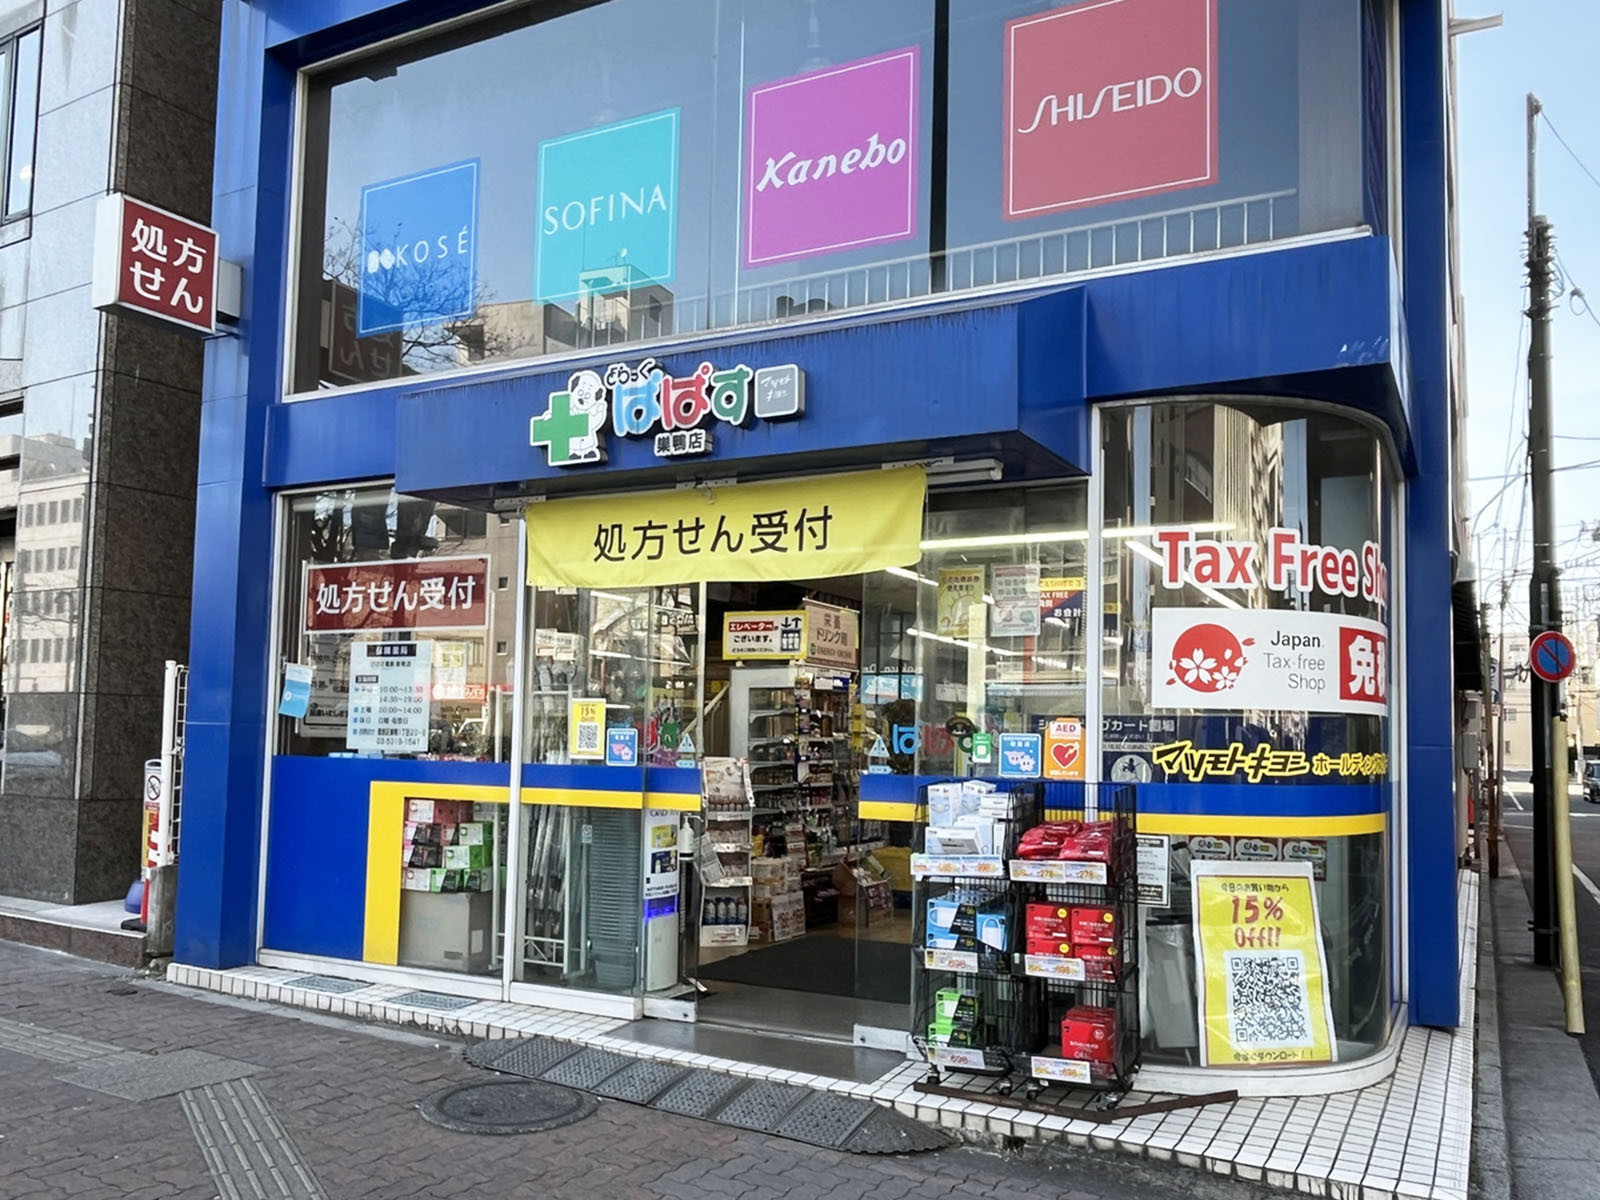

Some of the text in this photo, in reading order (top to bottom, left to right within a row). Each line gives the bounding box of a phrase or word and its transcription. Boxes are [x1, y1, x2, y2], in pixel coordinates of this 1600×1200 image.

[1018, 66, 1203, 135] SHISEIDO
[755, 132, 908, 193] Kanebo
[543, 183, 668, 236] SOFINA
[131, 218, 207, 274] 処方
[396, 225, 470, 268] KOSÉ
[130, 261, 203, 314] せん
[657, 432, 704, 454] 巣鴨店
[593, 504, 833, 563] 処方せん受付
[1157, 530, 1254, 585] Tax
[1272, 532, 1358, 593] Free
[315, 575, 476, 616] 処方せん受付
[1287, 673, 1326, 694] Shop
[1055, 723, 1077, 733] AED
[1153, 740, 1312, 781] マツモトキヨシ
[1231, 895, 1285, 924] 15%
